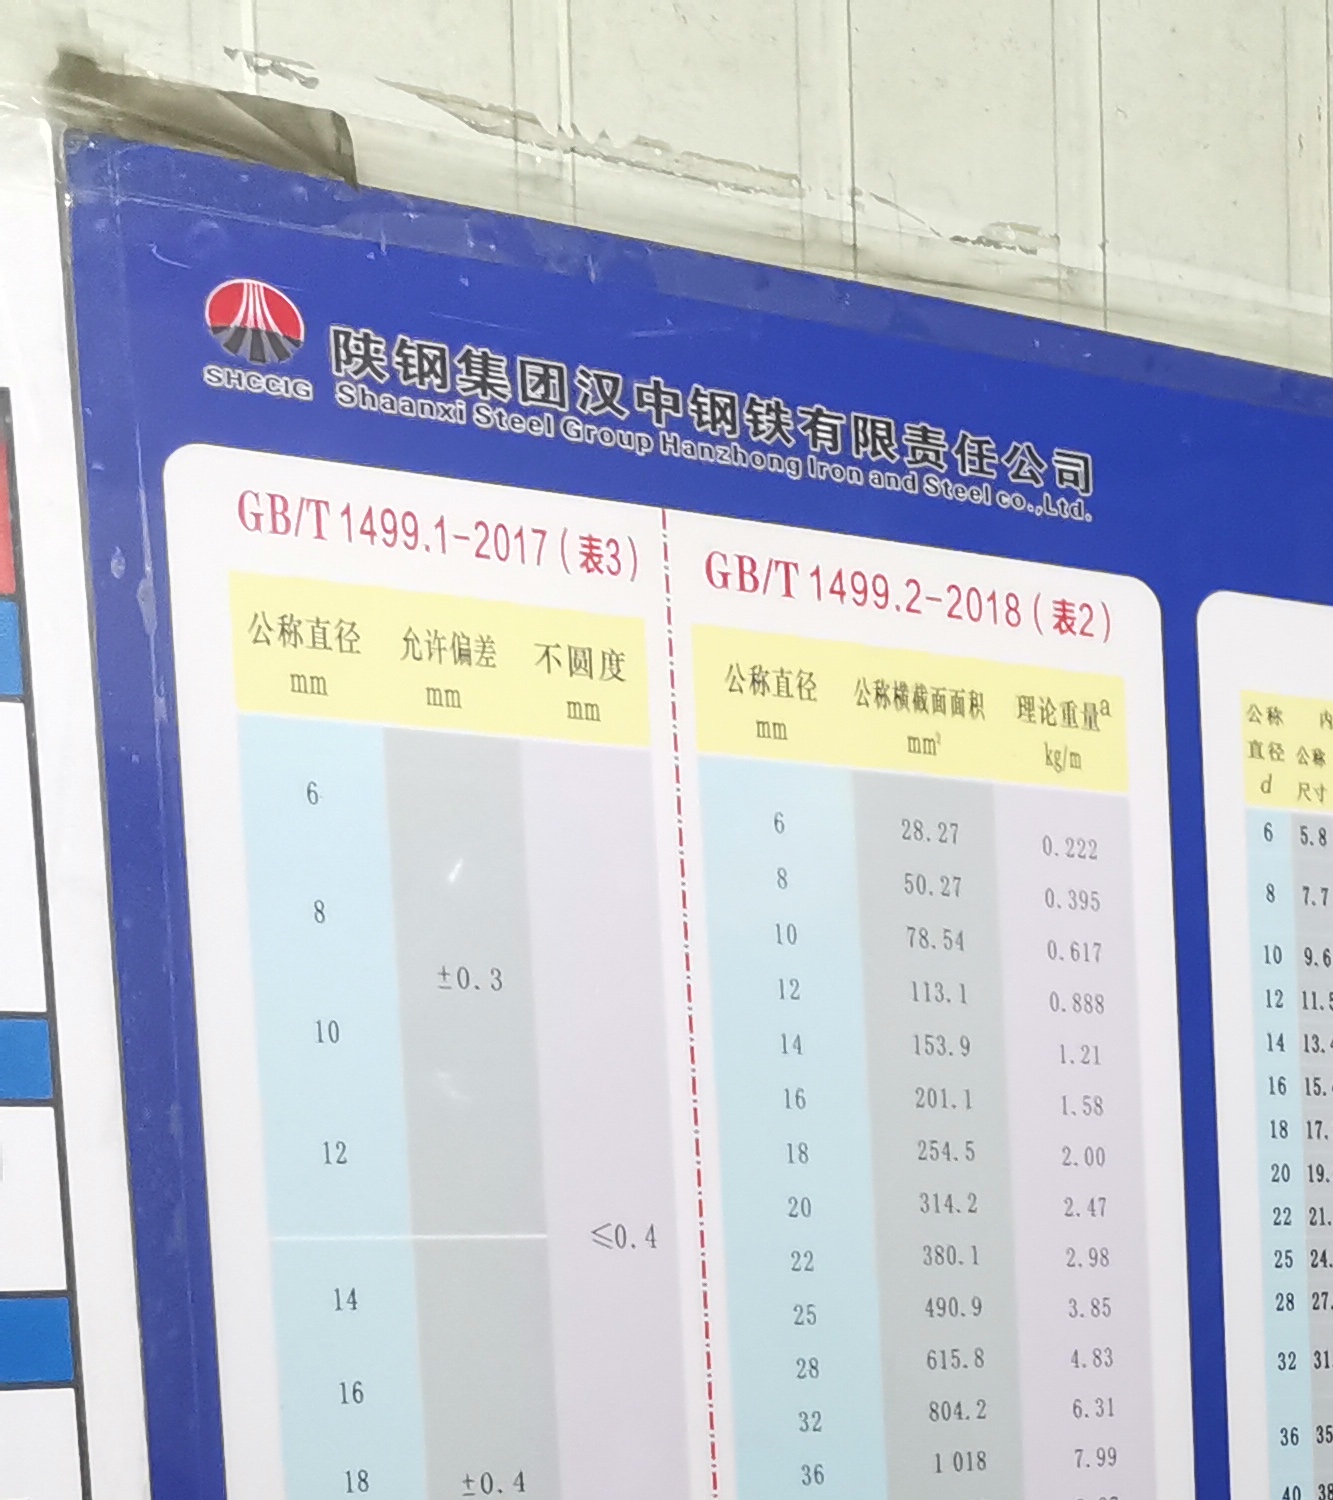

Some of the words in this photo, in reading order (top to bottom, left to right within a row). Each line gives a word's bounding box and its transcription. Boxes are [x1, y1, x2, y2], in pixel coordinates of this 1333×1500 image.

[203, 364, 314, 401] SHCCIG
[330, 324, 1095, 495] 陕钢集团汉中钢铁有限责任公司
[335, 381, 468, 426] Shaanxi
[473, 405, 554, 439] Steel
[560, 417, 655, 457] Group
[659, 433, 802, 480] Hanzhong
[807, 457, 864, 486] Iron
[869, 470, 918, 494] and
[922, 478, 992, 506] Steel
[248, 610, 362, 655] 公称直径
[400, 625, 497, 669] 允许偏差
[534, 642, 626, 683] 不圆度
[289, 673, 329, 697] mm
[725, 662, 818, 702] 公称直径
[424, 686, 463, 710] mm
[854, 676, 986, 721] 公称横截面面积
[566, 700, 602, 723] mm
[1246, 703, 1284, 727] 公称
[755, 719, 789, 741] mm
[1043, 741, 1082, 774] kg/m
[1248, 738, 1286, 763] 直径
[1296, 745, 1327, 768] 公称
[306, 780, 319, 806] 6
[1259, 772, 1273, 795] d
[1296, 781, 1328, 804] 尺寸
[773, 811, 786, 835] 6
[901, 818, 959, 845] 28.27
[1263, 821, 1274, 843] 6
[1041, 834, 1098, 861] 0.222
[1299, 824, 1328, 848] 5.8
[776, 866, 789, 890] 8
[903, 872, 962, 898] 50.27
[1044, 887, 1101, 913] 0.395
[1265, 882, 1276, 904] 8
[1302, 885, 1330, 907] 7.7
[313, 899, 326, 924] 8
[775, 922, 798, 946] 10
[906, 925, 965, 952] 78.54
[1046, 939, 1102, 963] 0.617
[1263, 944, 1283, 965] 10
[1303, 946, 1332, 969] 9.6
[437, 965, 503, 992] ±0.3
[778, 977, 801, 1001] 12
[911, 980, 967, 1005] 113.1
[1049, 990, 1105, 1015] 0.888
[1265, 988, 1284, 1009] 12
[315, 1019, 340, 1044] 10
[1266, 1032, 1286, 1053] 14
[780, 1032, 803, 1056] 14
[913, 1033, 971, 1058] 153.9
[1059, 1043, 1101, 1066] 1.21
[1268, 1075, 1287, 1096] 16
[783, 1086, 807, 1110] 16
[914, 1086, 972, 1111] 201.1
[1061, 1094, 1105, 1117] 1.58
[1269, 1119, 1289, 1140] 18
[323, 1140, 348, 1165] 12
[786, 1141, 810, 1165] 18
[917, 1139, 976, 1162] 254.5
[1061, 1145, 1106, 1168] 2.00
[1270, 1162, 1291, 1184] 20
[787, 1195, 812, 1219] 20
[918, 1191, 978, 1215] 314.2
[1062, 1196, 1107, 1218] 2.47
[1272, 1206, 1292, 1227] 22
[790, 1249, 815, 1273] 22
[922, 1244, 979, 1267] 380.1
[1065, 1246, 1110, 1269] 2.98
[1273, 1248, 1294, 1269] 25
[334, 1287, 358, 1312] 14
[924, 1295, 983, 1319] 490.9
[1068, 1296, 1112, 1319] 3.85
[1275, 1291, 1295, 1312] 28
[792, 1303, 817, 1326] 25
[795, 1356, 820, 1380] 28
[926, 1346, 985, 1371] 615.8
[1070, 1346, 1114, 1369] 4.83
[1277, 1350, 1297, 1372] 32
[339, 1380, 365, 1405] 16
[928, 1398, 987, 1423] 804.2
[1072, 1396, 1115, 1420] 6.31
[798, 1410, 823, 1433] 32
[1279, 1426, 1300, 1447] 36
[1074, 1446, 1118, 1469] 7.99
[345, 1468, 370, 1494] 18
[462, 1470, 526, 1497] ±0.4
[800, 1463, 825, 1487] 36
